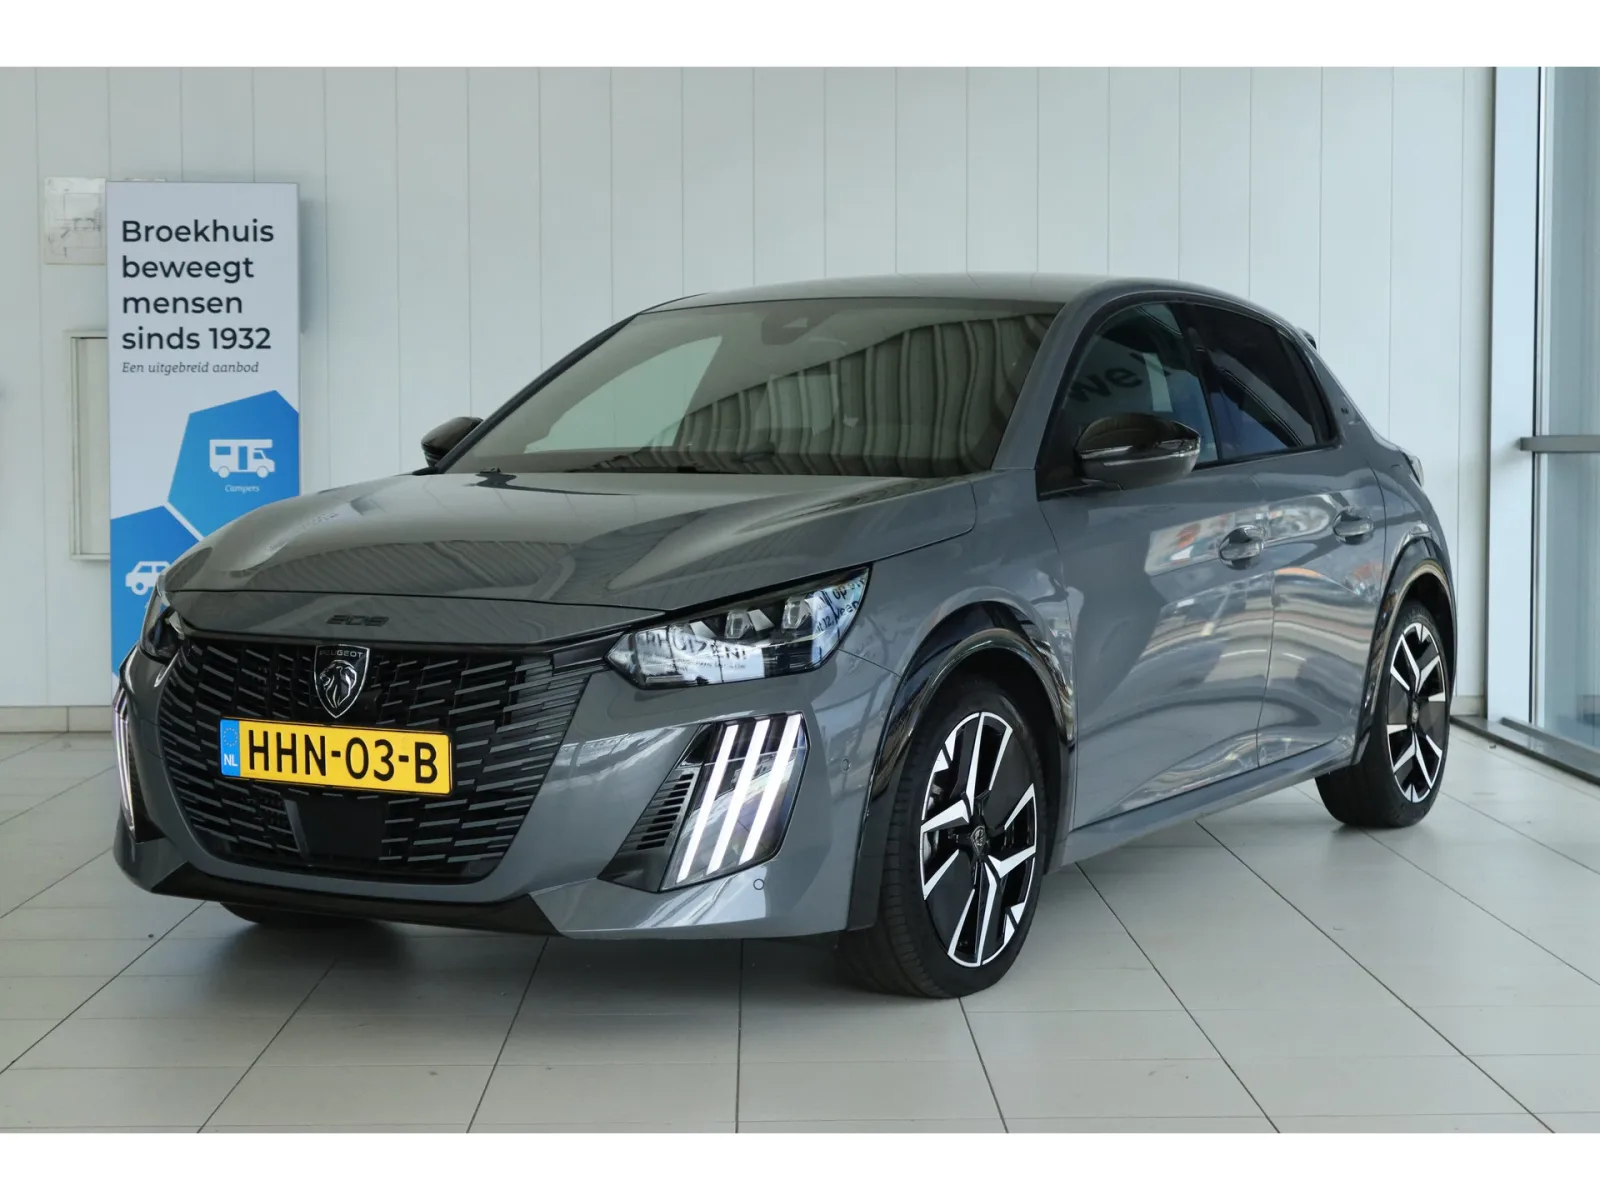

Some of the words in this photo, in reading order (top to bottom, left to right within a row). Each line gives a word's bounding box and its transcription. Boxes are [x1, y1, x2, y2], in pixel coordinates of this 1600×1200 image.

[122, 218, 275, 242] Broekhuis
[122, 255, 255, 284] beweegt
[122, 295, 243, 314] mensen
[122, 325, 201, 350] sinds
[208, 327, 272, 350] 1932
[121, 361, 145, 374] Een
[148, 361, 209, 376] uitgebreid
[212, 361, 259, 374] aanbod
[224, 484, 260, 494] Campers
[326, 614, 390, 627] 208
[319, 649, 364, 659] PEUGEOT
[223, 754, 238, 767] NL
[248, 729, 438, 785] HHN-03-B
